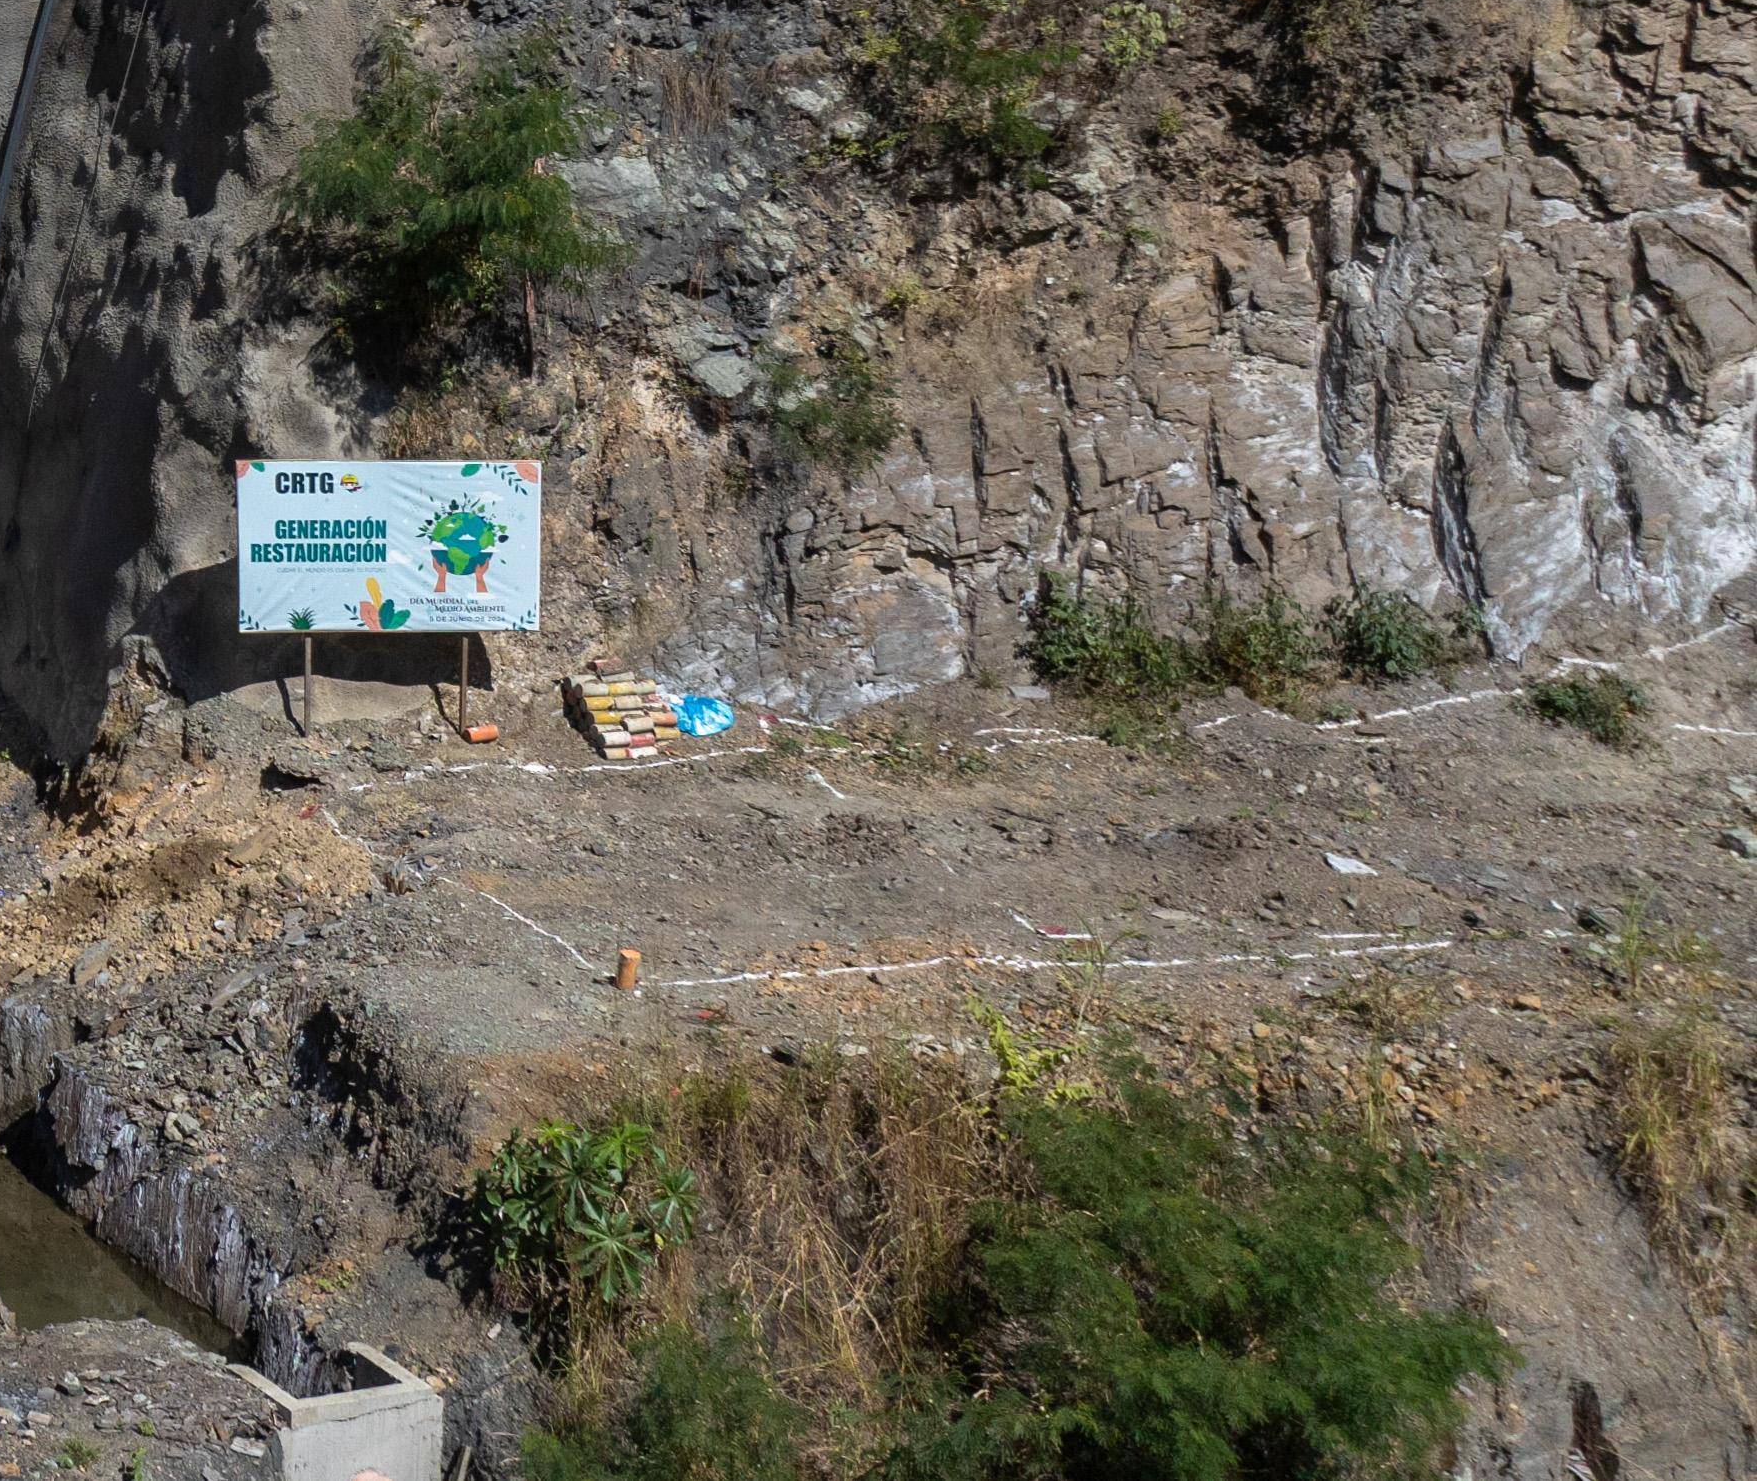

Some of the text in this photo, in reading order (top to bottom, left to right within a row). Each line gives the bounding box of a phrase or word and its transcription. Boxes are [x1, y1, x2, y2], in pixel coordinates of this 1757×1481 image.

[275, 472, 334, 494] CRTG
[275, 516, 387, 540] GENERACIÓN
[250, 540, 387, 563] RESTAURACIÓN
[465, 605, 506, 613] AMBIENTE
